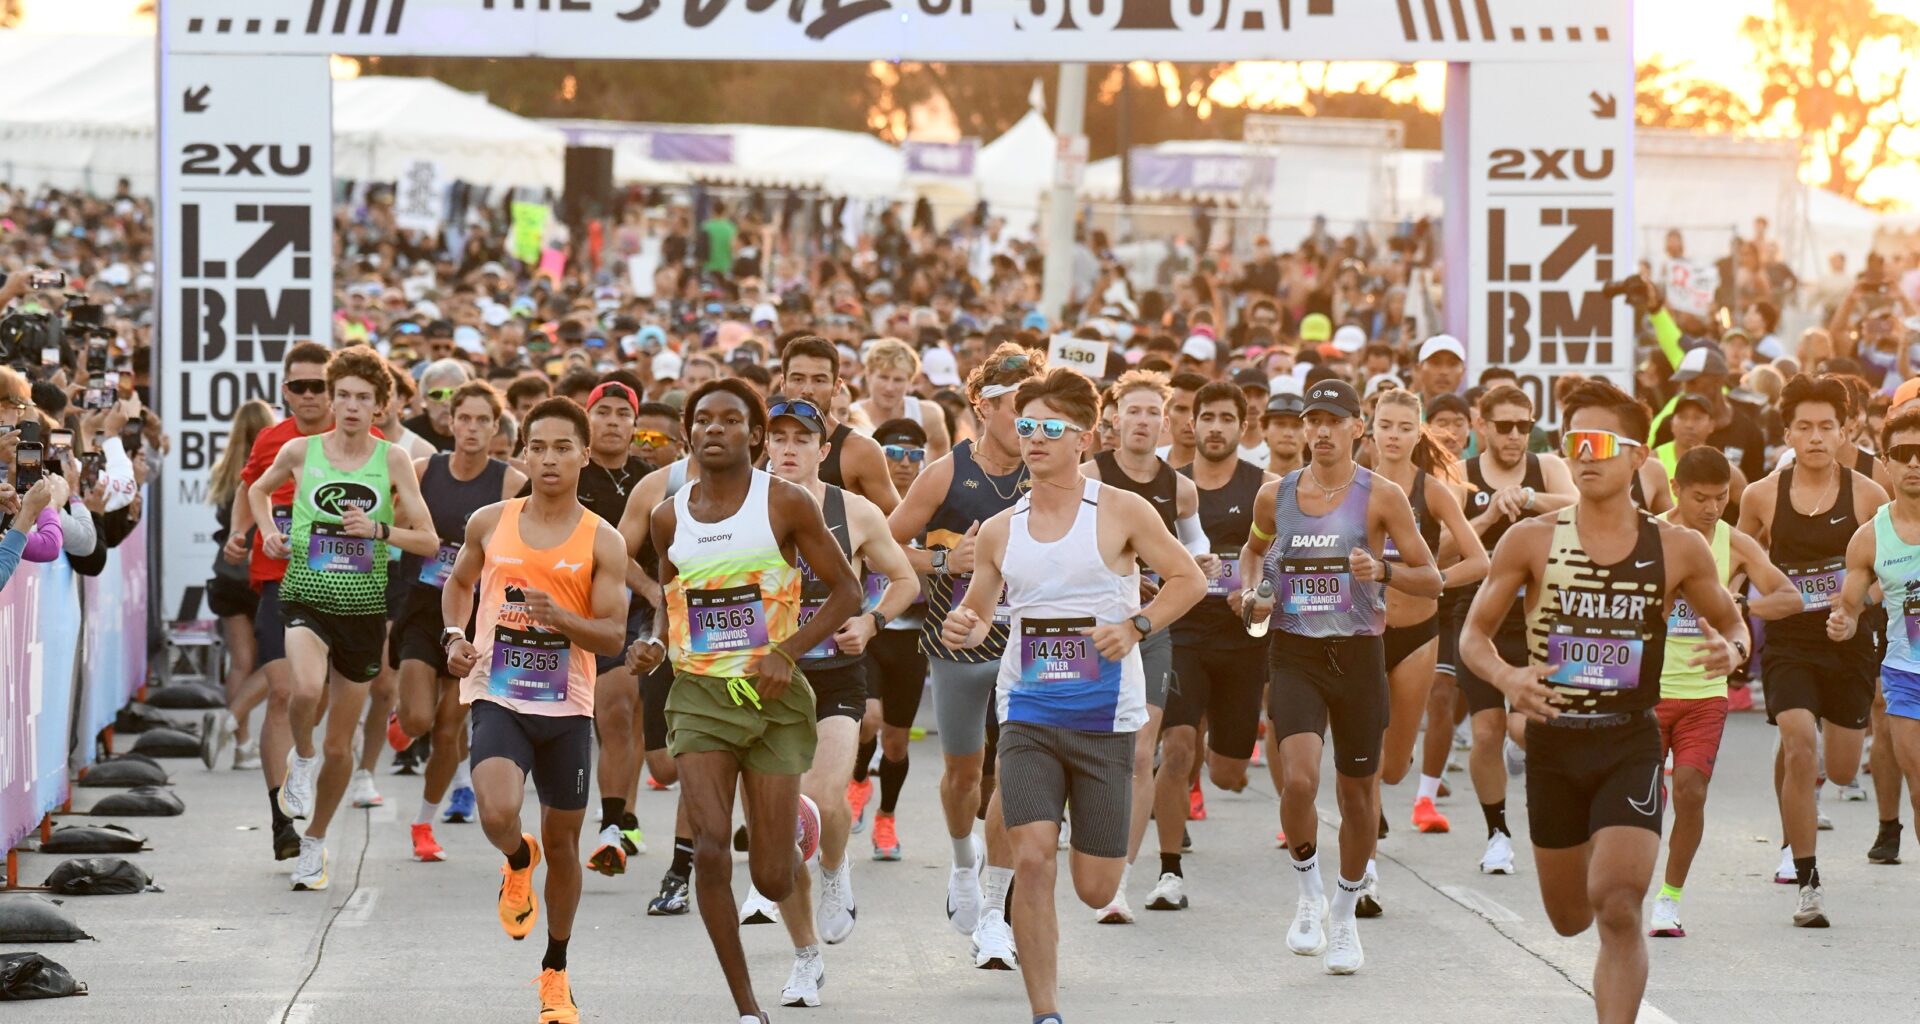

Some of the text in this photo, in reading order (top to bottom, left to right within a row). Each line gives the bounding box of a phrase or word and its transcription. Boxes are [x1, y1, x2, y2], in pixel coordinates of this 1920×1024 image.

[181, 144, 311, 176] 2XU
[1488, 149, 1614, 180] 2XU
[1488, 291, 1612, 364] BM
[1059, 347, 1095, 364] 1:30
[181, 372, 290, 421] LON
[319, 486, 372, 516] Running
[320, 540, 365, 556] 11666
[698, 533, 732, 543] saucony
[1291, 535, 1340, 547] BANDIT
[1289, 577, 1340, 595] 11980
[1558, 589, 1646, 620] VALOR
[696, 607, 755, 631] 14563
[707, 629, 747, 641] JAQUAVIOUS
[503, 648, 559, 671] 15253
[1030, 640, 1087, 660] 14431
[1559, 642, 1630, 665] 10020
[1046, 661, 1069, 671] TYLER
[1583, 665, 1605, 677] LUKE
